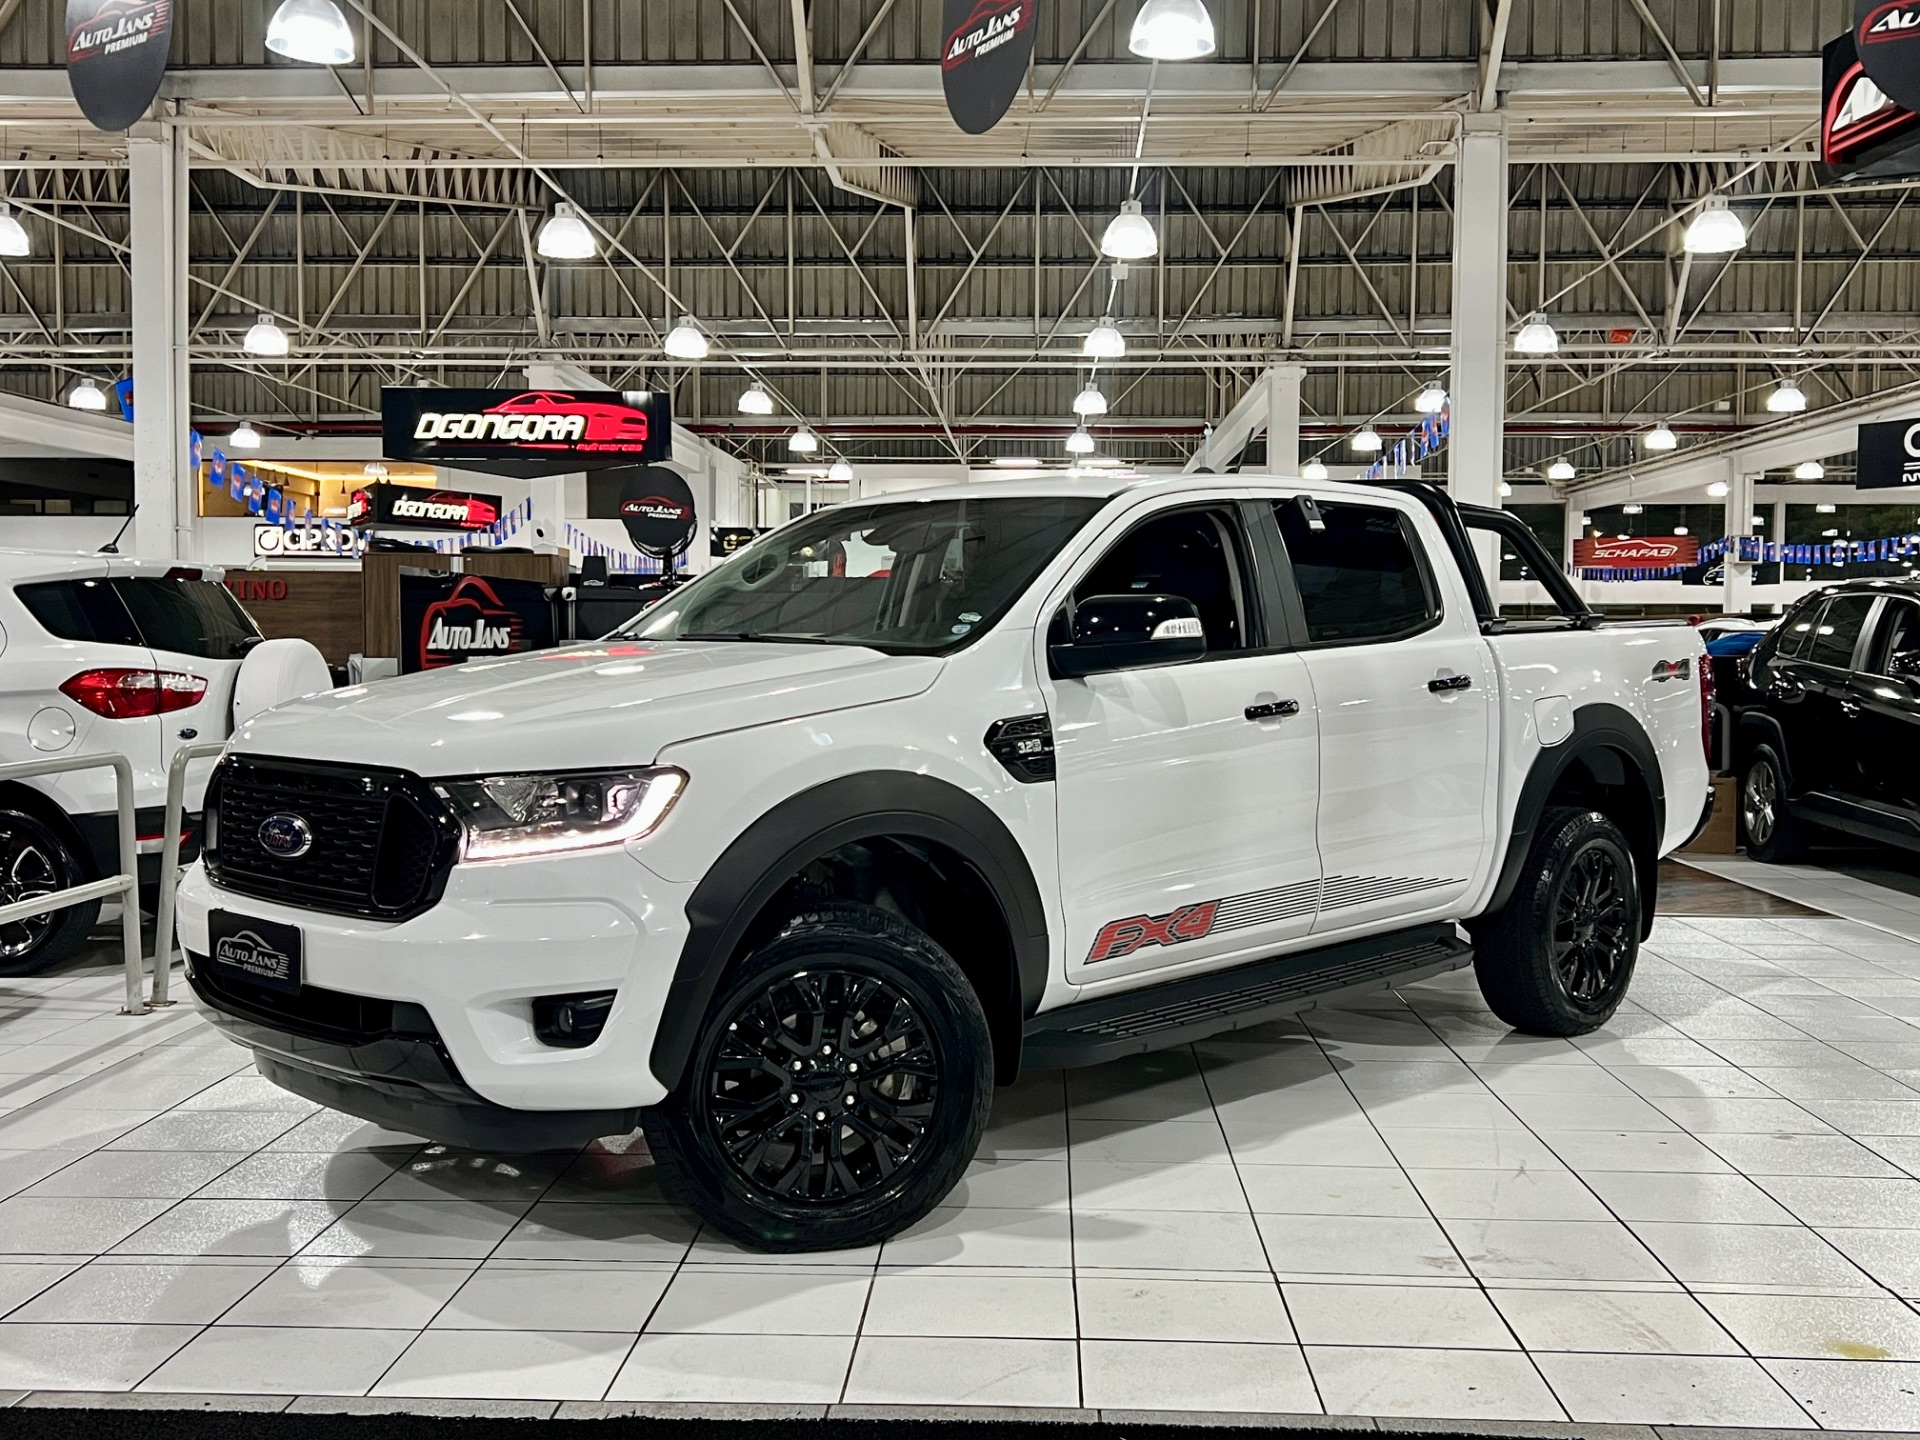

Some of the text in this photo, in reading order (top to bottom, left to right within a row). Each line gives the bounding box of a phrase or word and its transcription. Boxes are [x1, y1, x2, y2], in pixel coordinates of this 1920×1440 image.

[104, 31, 148, 55] PREMIUM
[974, 27, 1015, 58] PREMIUM
[1592, 549, 1672, 558] SCHAFAS
[1084, 900, 1222, 964] FX4
[243, 963, 275, 978] PREMIUM
